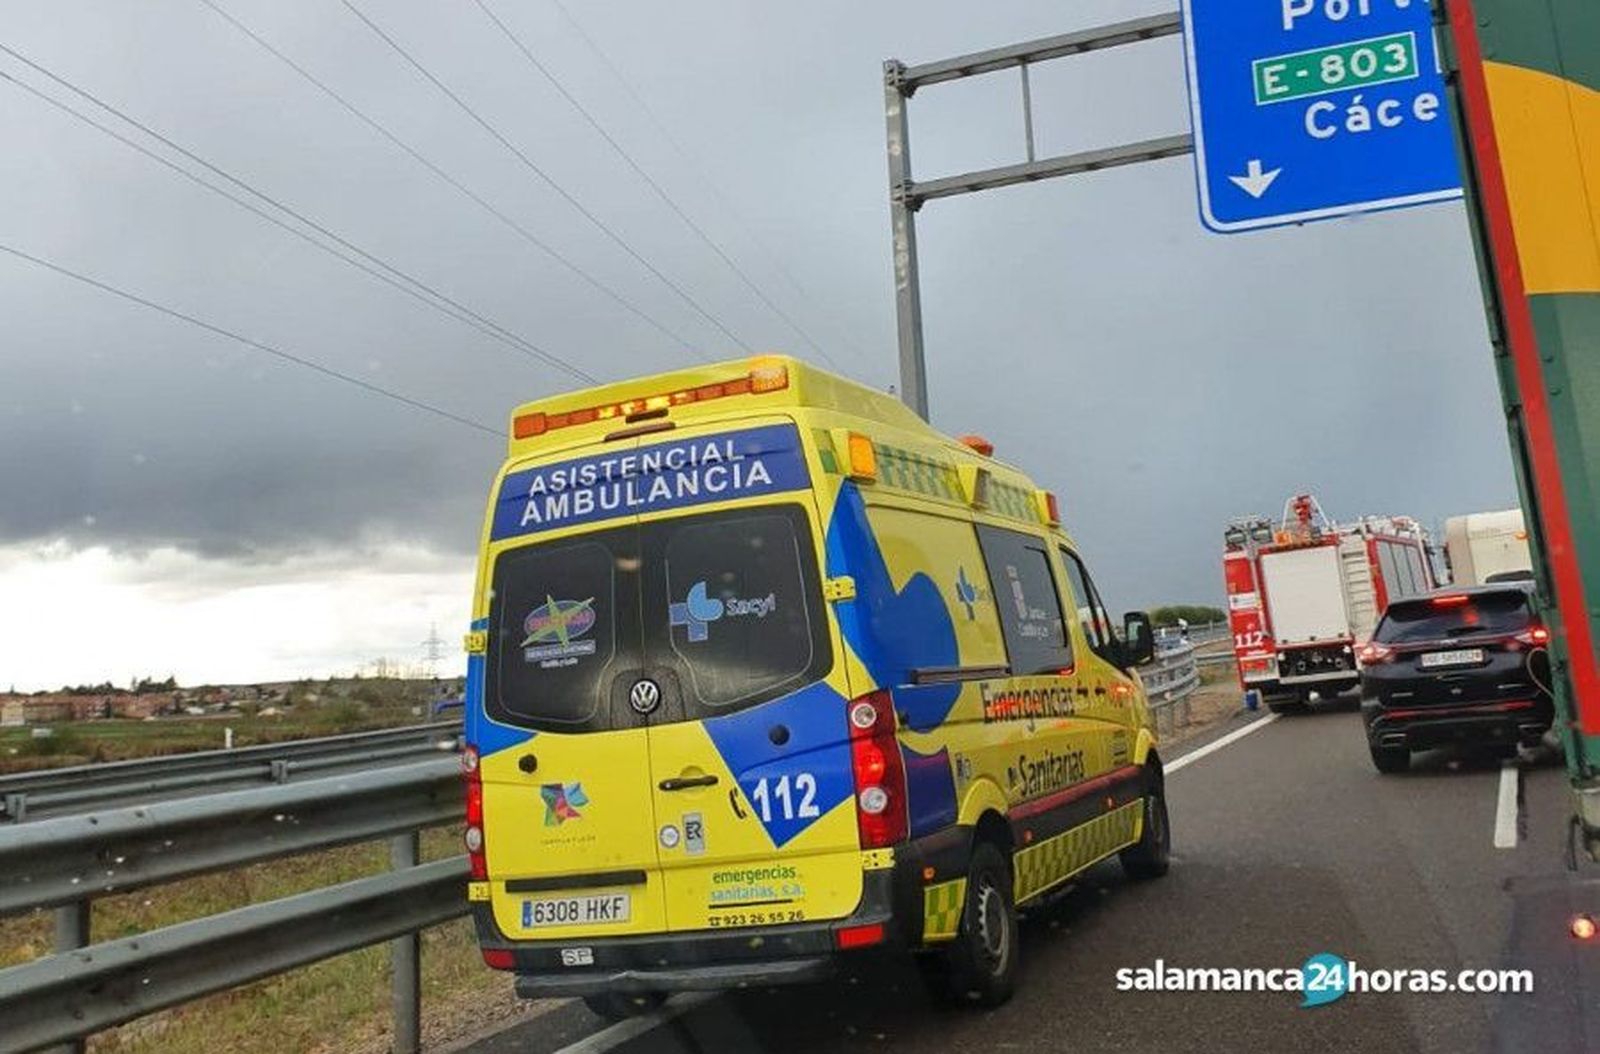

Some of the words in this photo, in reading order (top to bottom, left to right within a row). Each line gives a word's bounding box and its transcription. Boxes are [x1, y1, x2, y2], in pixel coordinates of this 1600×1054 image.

[1282, 0, 1410, 30] Por
[529, 439, 745, 498] ASISTENCIAL
[520, 460, 773, 528] AMBULANCIA
[1235, 631, 1264, 649] 112
[1018, 744, 1085, 797] Sanitarias
[753, 773, 820, 822] 112
[712, 864, 796, 884] emergencias
[534, 900, 579, 923] 6308
[586, 896, 625, 920] HKF
[724, 914, 746, 925] 923
